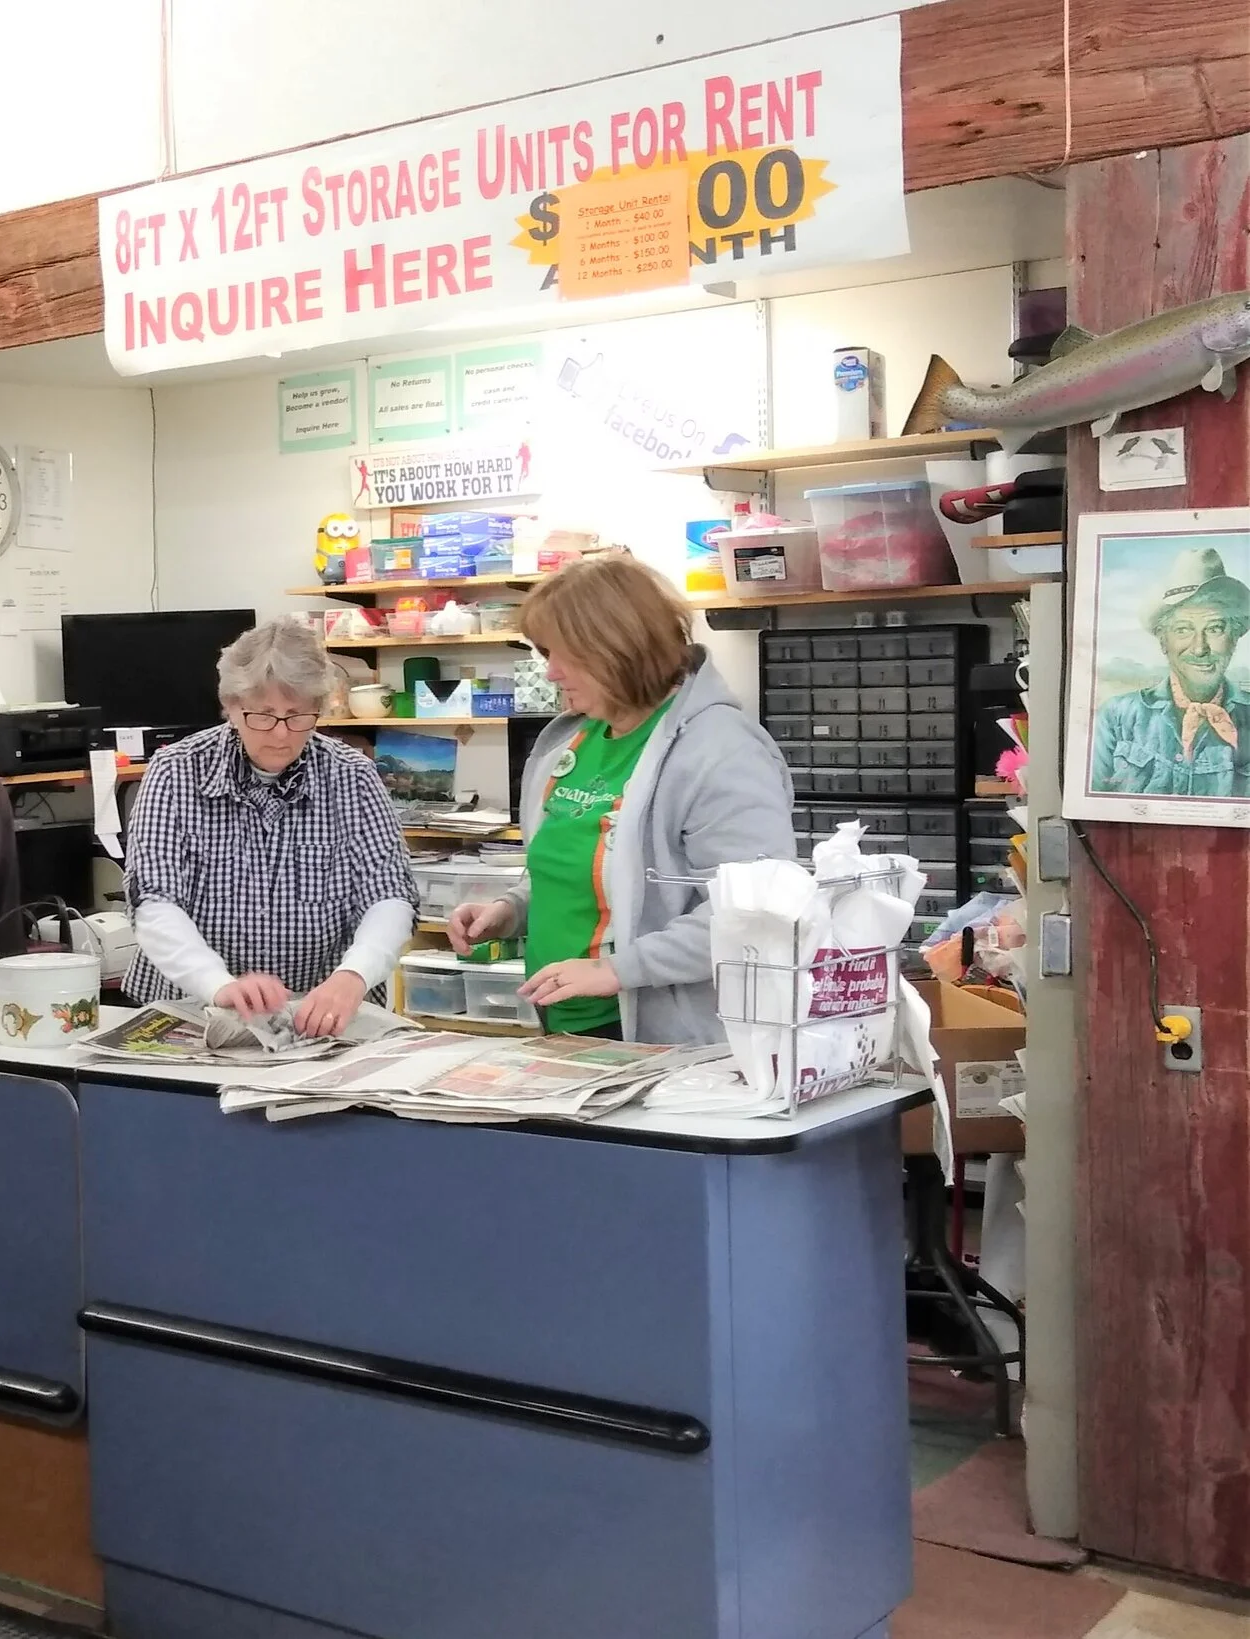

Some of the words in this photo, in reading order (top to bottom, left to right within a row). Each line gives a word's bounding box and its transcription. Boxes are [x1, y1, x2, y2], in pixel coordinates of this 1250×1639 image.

[115, 209, 166, 274] 8FT
[178, 207, 200, 262] X
[211, 182, 288, 254] 12FT
[301, 148, 462, 236] STORAGE
[477, 120, 595, 200] UNITS
[610, 101, 688, 175] FOR
[704, 70, 822, 156] RENT
[578, 204, 615, 216] Storage
[618, 199, 638, 210] Unit
[642, 194, 671, 205] Rental
[594, 217, 621, 228] Month
[633, 208, 664, 222] $40.00
[580, 243, 586, 252] 3
[589, 239, 621, 250] Months
[633, 230, 669, 244] $100.00
[689, 224, 797, 267] NTH
[580, 258, 586, 266] 6
[589, 254, 620, 264] Months
[633, 245, 669, 259] $150.00
[577, 271, 588, 280] 12
[591, 268, 623, 278] Months
[636, 259, 673, 273] $250.00
[124, 268, 324, 351] INQUIRE
[343, 234, 493, 313] HERE
[402, 377, 432, 387] Returns
[292, 391, 309, 400] Help
[320, 387, 340, 397] grow,
[285, 402, 313, 412] Become
[378, 405, 389, 413] All
[390, 403, 409, 412] sales
[410, 402, 424, 410] are
[425, 400, 445, 408] final.
[295, 425, 321, 434] Inquire
[321, 421, 339, 430] Here
[373, 469, 397, 484] IT'S
[399, 464, 441, 482] ABOUT
[444, 460, 473, 478] HOW
[477, 457, 513, 474] HARD
[374, 484, 406, 504] YOU
[410, 479, 458, 501] WORK
[462, 476, 493, 496] FOR
[498, 474, 514, 493] IT
[0, 493, 7, 510] 3
